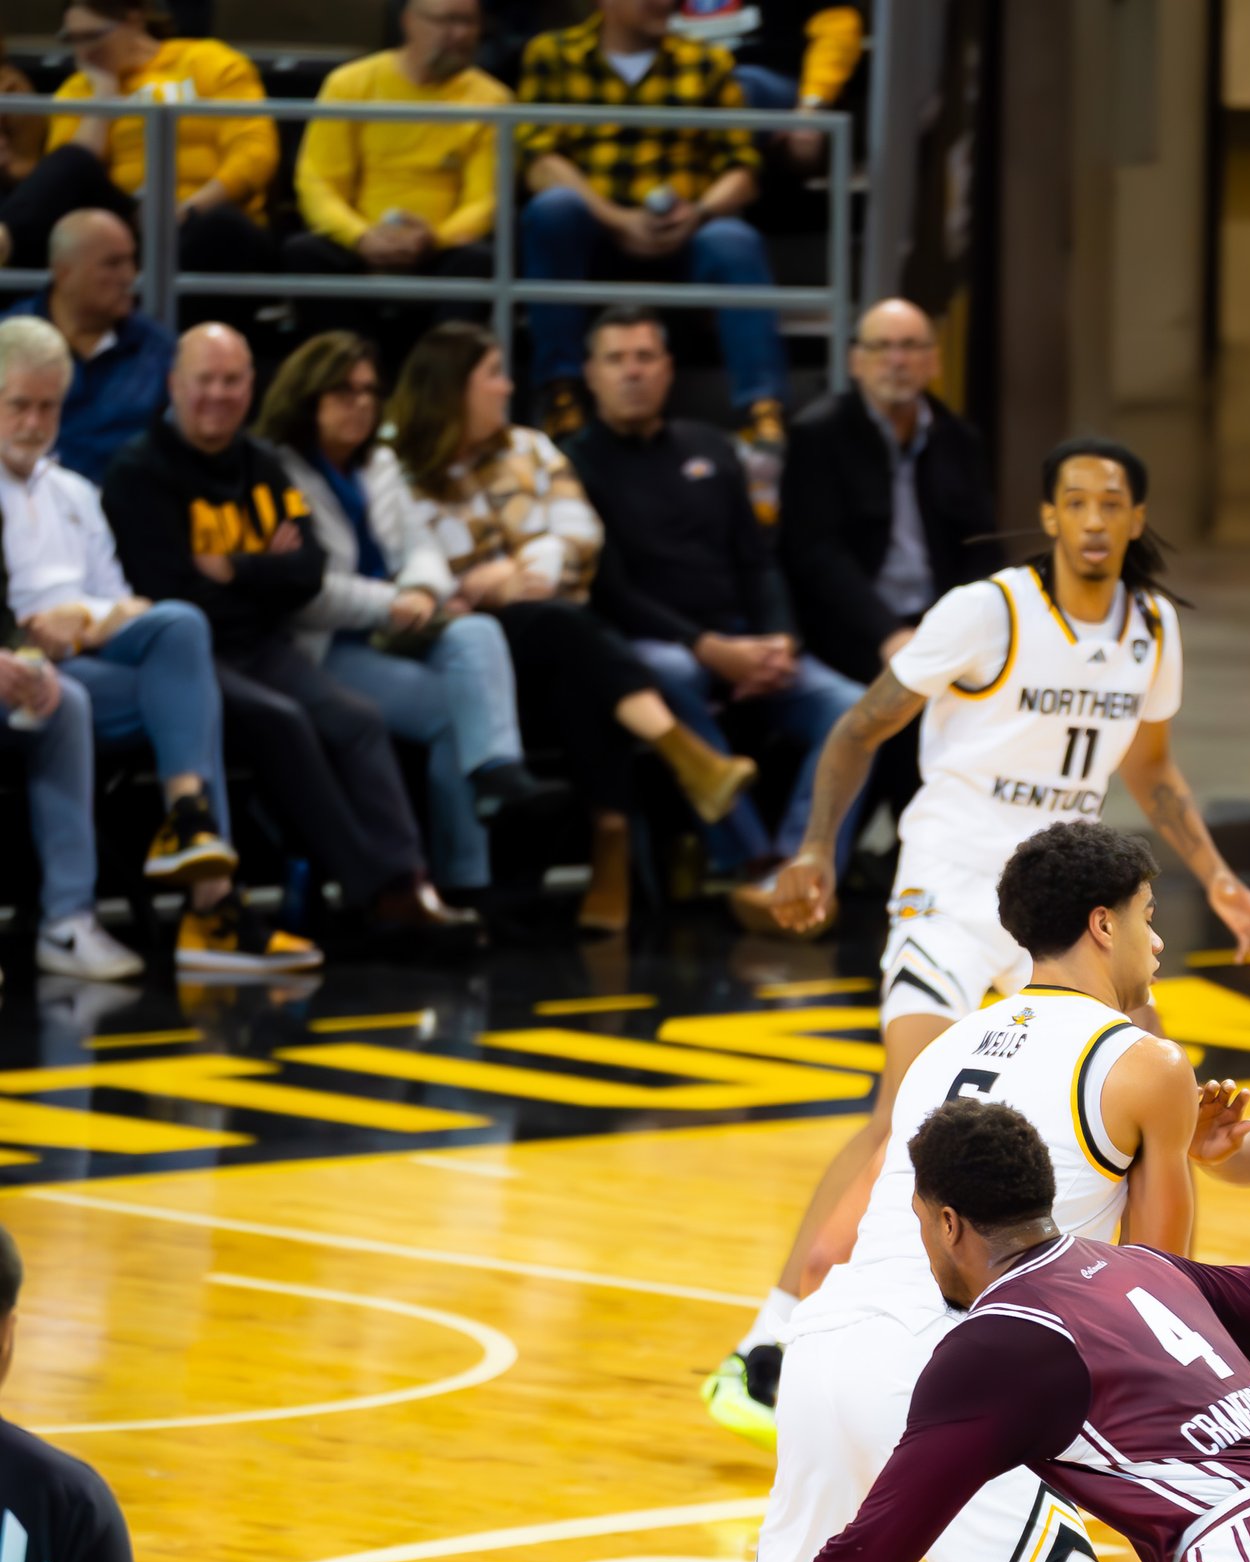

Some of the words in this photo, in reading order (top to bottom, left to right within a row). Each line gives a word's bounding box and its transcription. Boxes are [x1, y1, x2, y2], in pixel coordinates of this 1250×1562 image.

[1060, 727, 1099, 779] 11
[971, 1030, 1027, 1059] WELLS
[1126, 1286, 1234, 1380] 4
